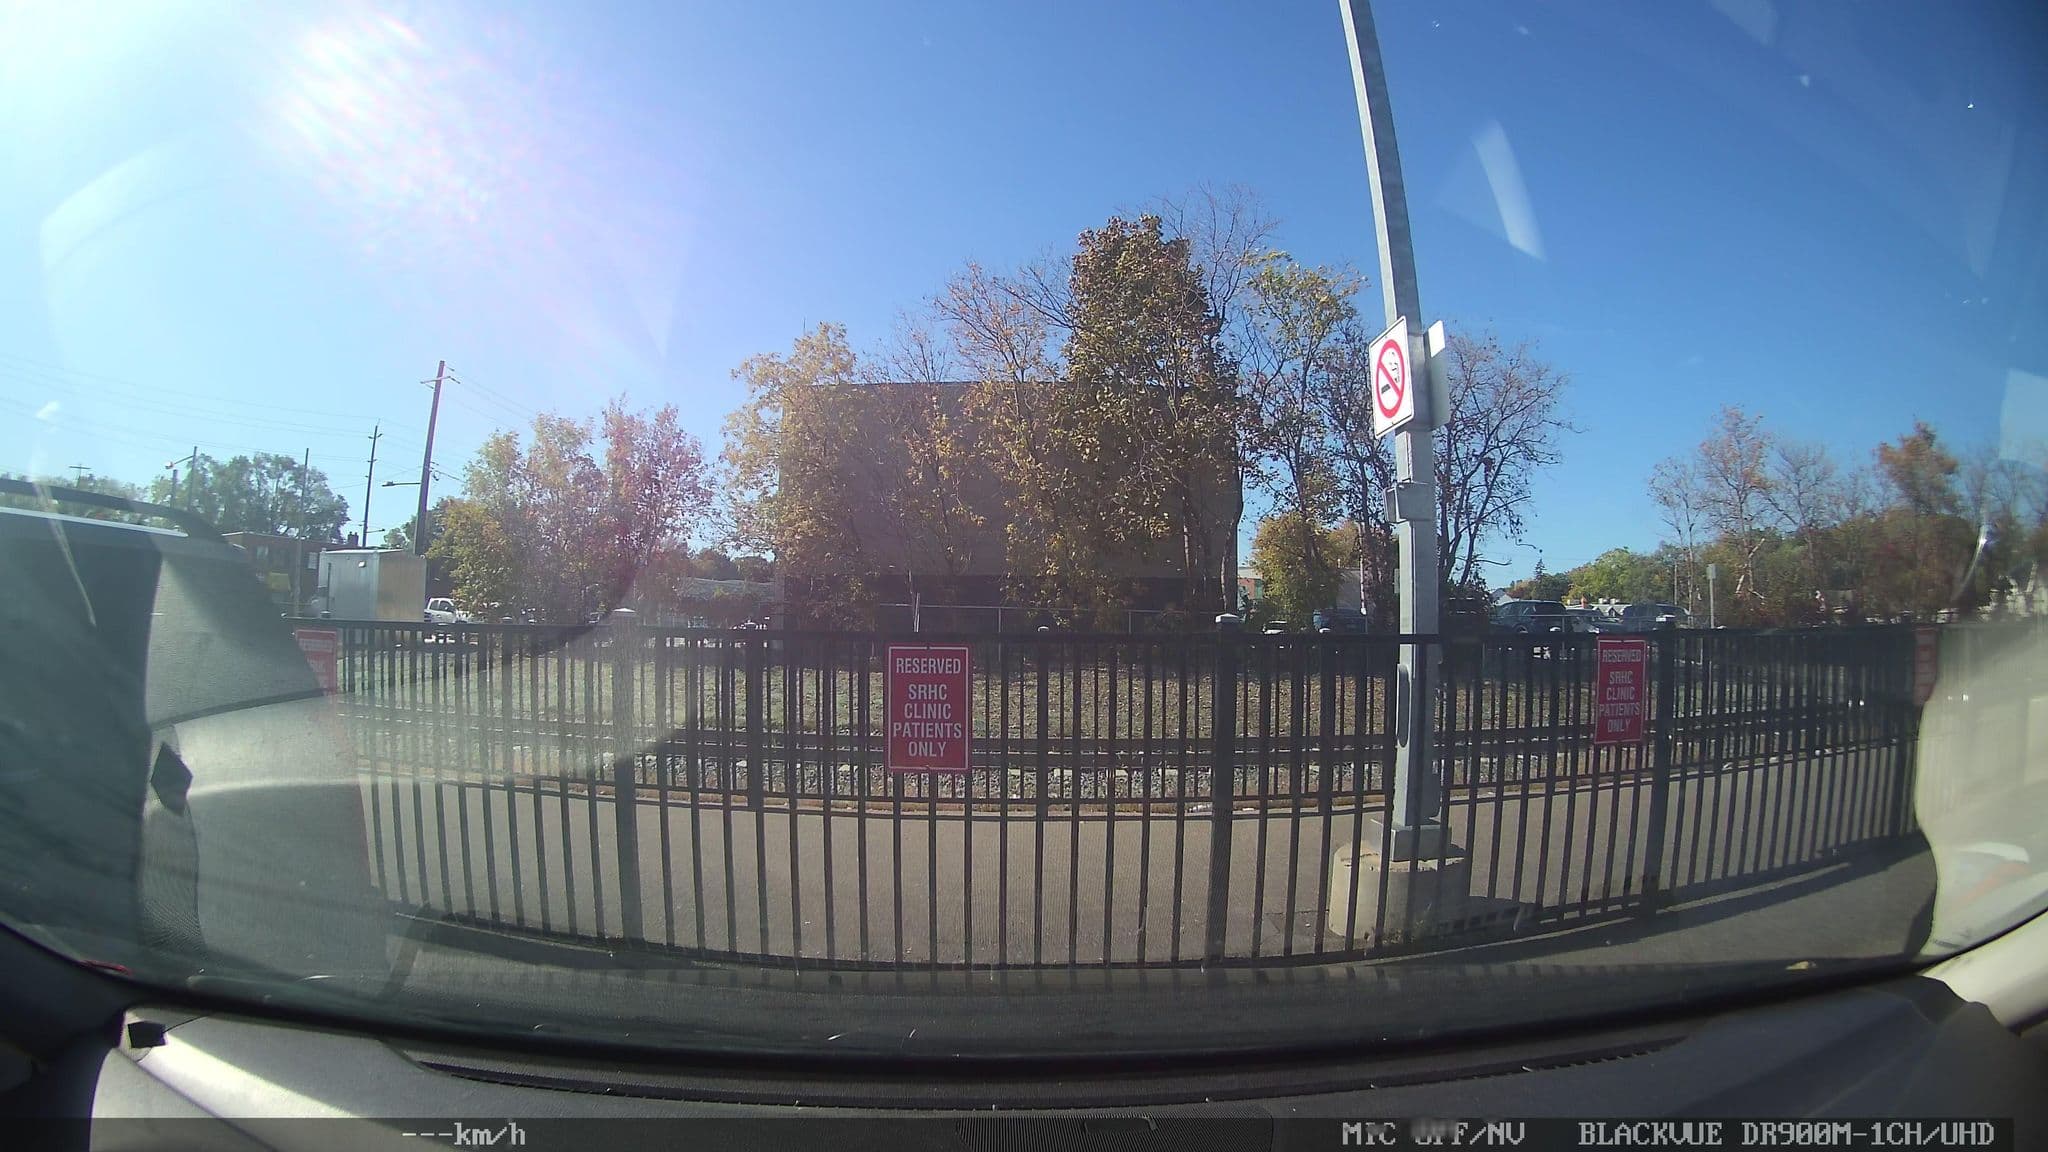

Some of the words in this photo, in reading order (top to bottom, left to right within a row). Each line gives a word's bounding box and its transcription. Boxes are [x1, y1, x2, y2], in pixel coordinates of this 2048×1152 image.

[896, 657, 962, 674] RESERVED
[908, 684, 947, 700] SRHC
[1606, 686, 1635, 701] CLINIC
[904, 703, 952, 719] CLINIC
[893, 722, 962, 739] PATIENTS
[908, 741, 947, 758] ONLY
